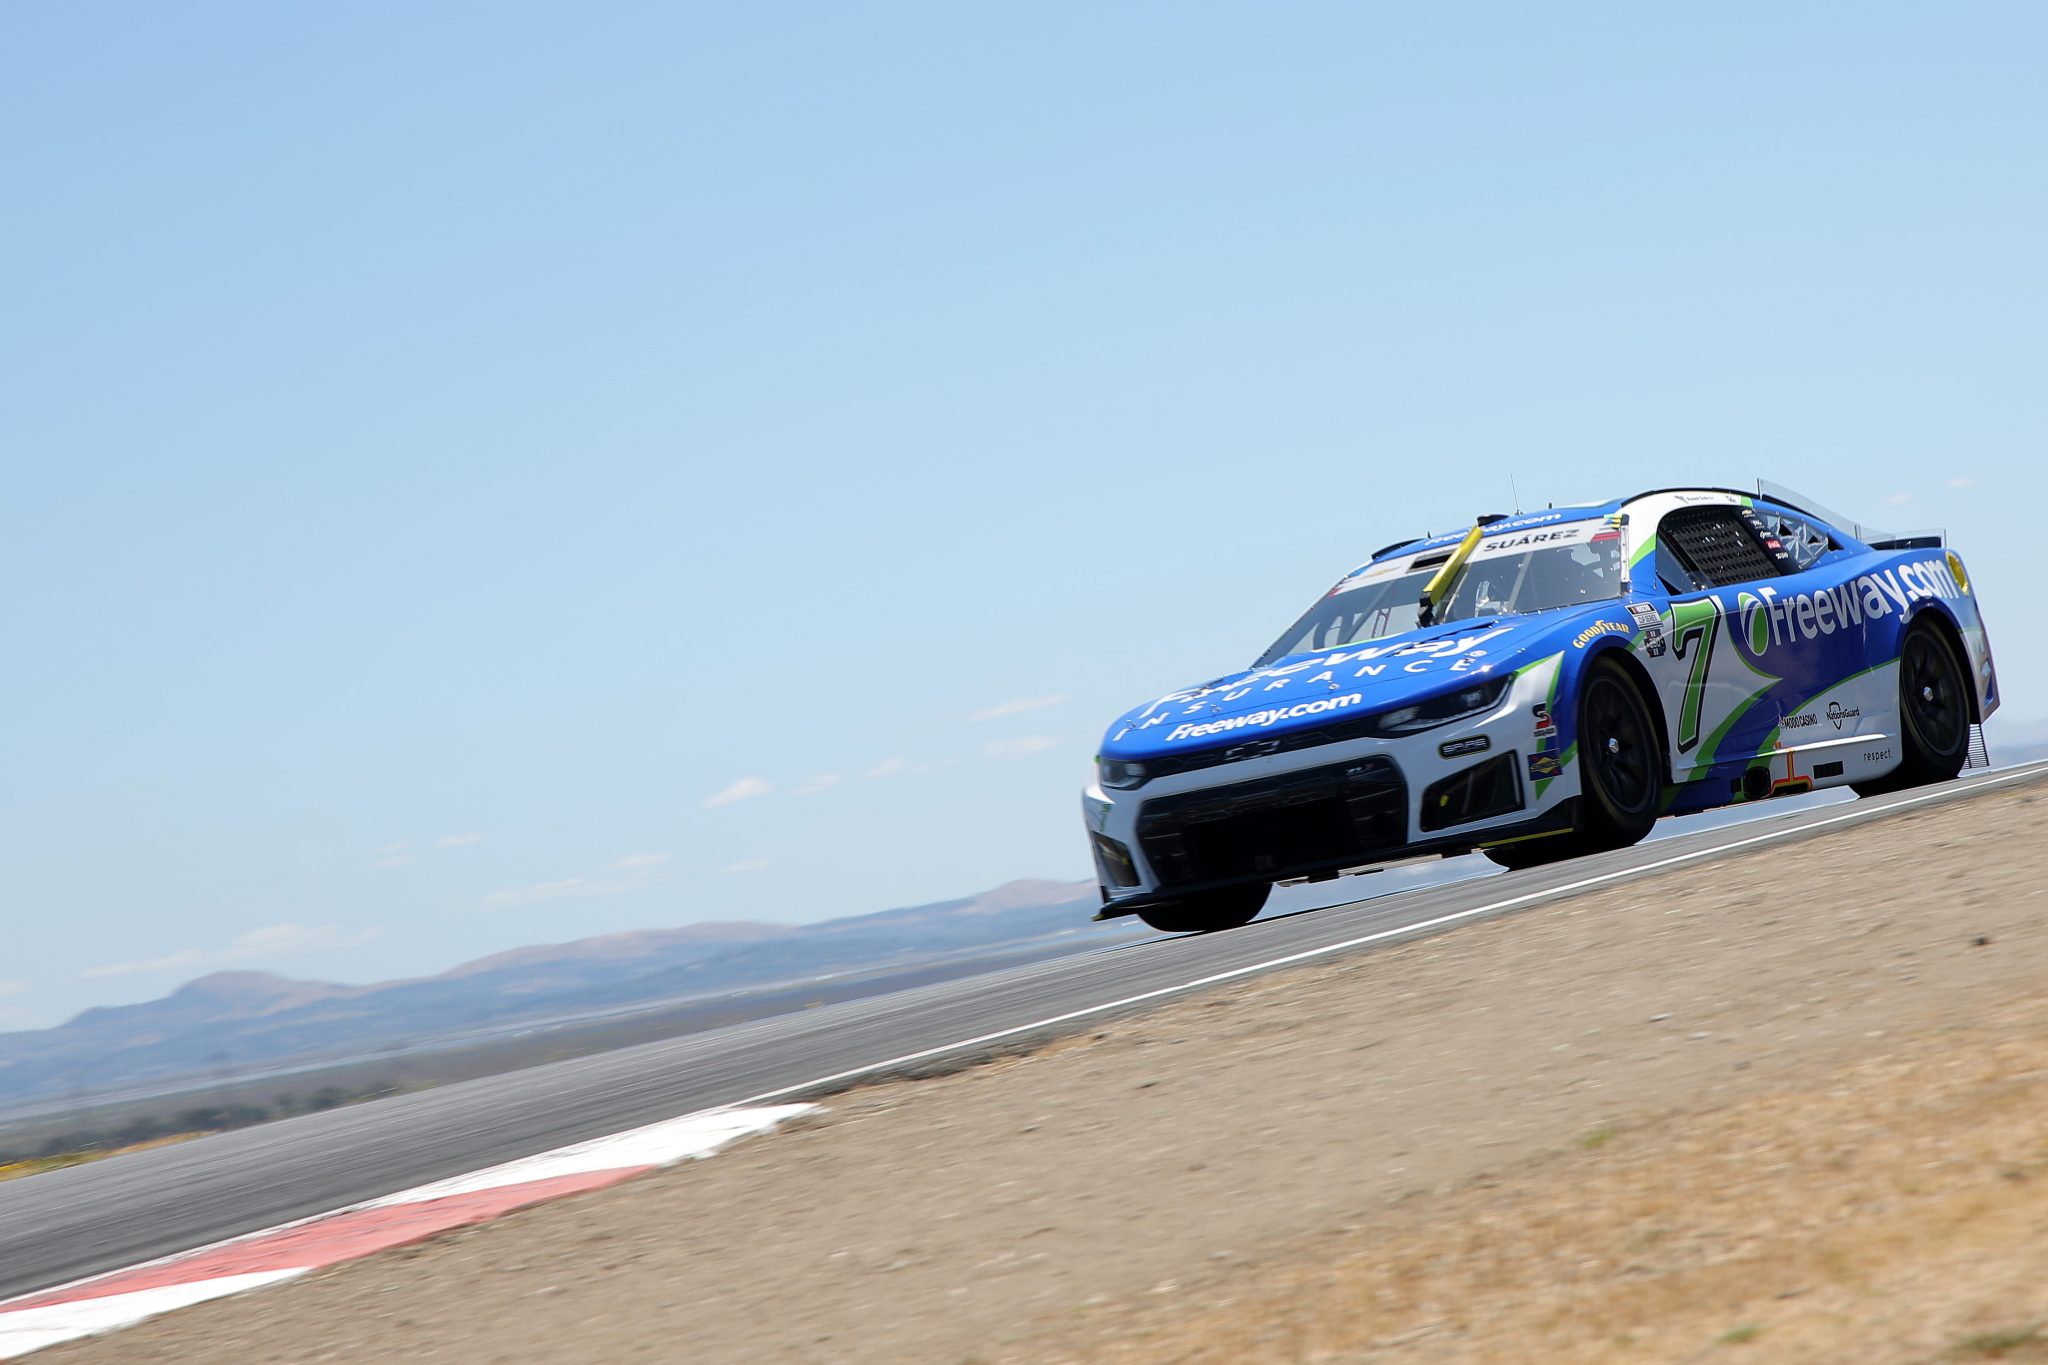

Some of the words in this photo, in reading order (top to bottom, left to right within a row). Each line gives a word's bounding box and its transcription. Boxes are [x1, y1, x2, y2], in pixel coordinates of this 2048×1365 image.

[1484, 529, 1579, 552] SUÁREZ
[1758, 559, 1960, 646] Freeway.com
[1572, 619, 1630, 649] GOODYEAR
[1669, 595, 1721, 754] 7
[1165, 693, 1362, 741] Freeway.com
[1799, 714, 1818, 727] CASINO
